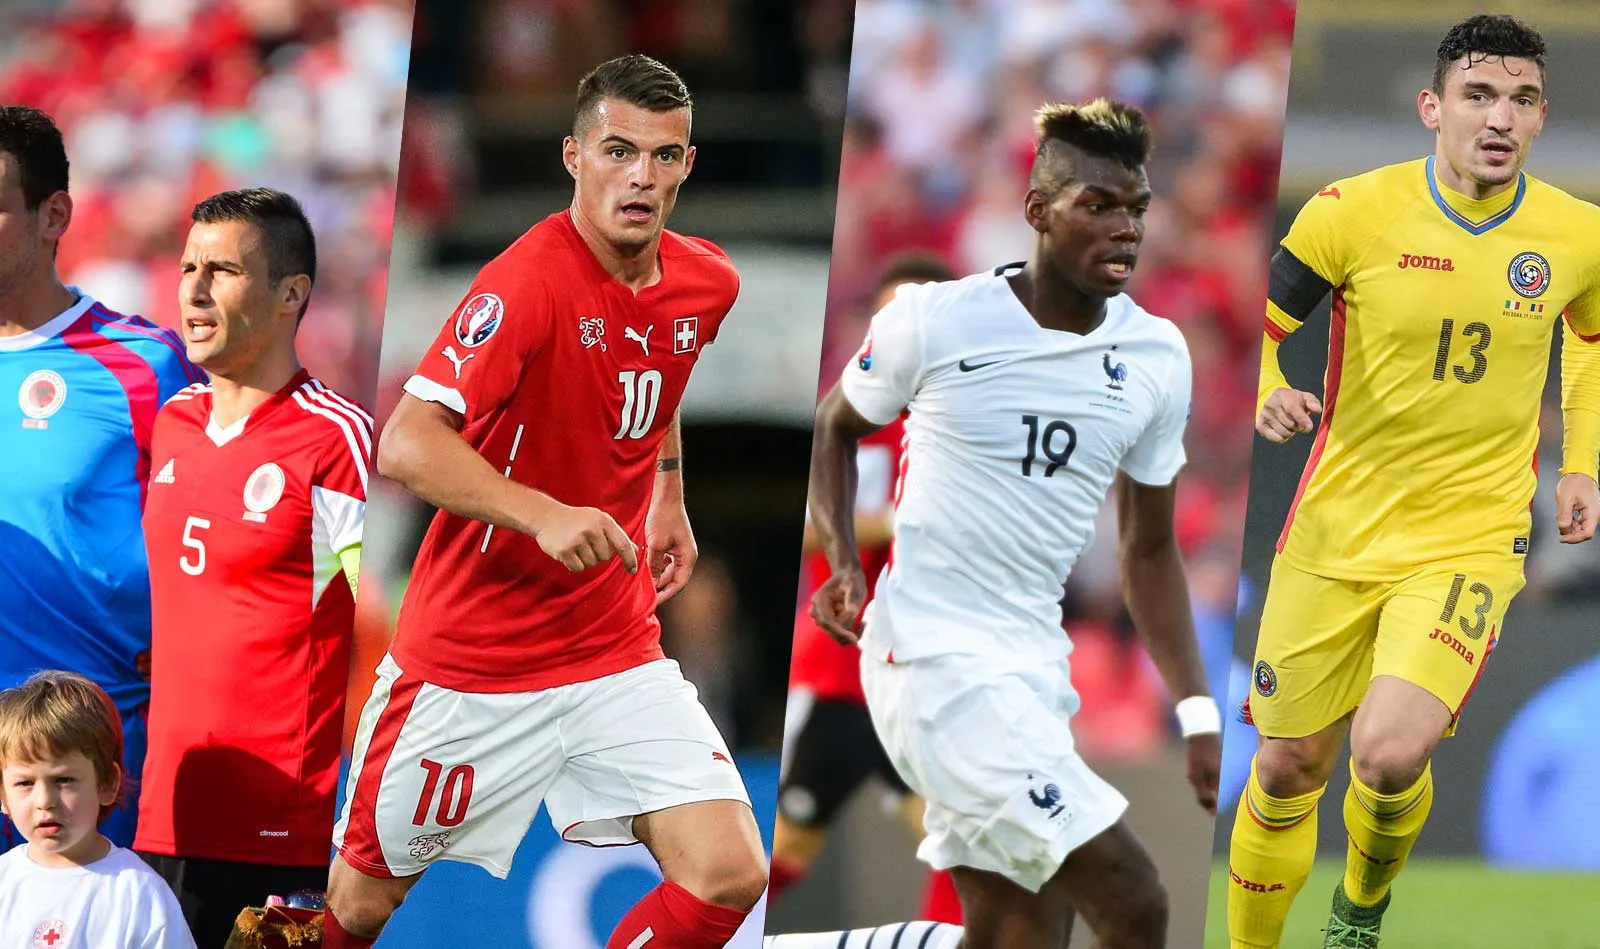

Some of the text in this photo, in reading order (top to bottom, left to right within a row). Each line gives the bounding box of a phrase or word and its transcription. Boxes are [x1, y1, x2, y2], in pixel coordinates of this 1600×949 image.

[1398, 253, 1455, 272] Joma
[1432, 318, 1492, 385] 13
[614, 370, 663, 440] 10
[1021, 415, 1078, 478] 19
[180, 515, 211, 576] 5
[1439, 573, 1494, 640] 13
[1429, 628, 1474, 666] Joma
[412, 758, 475, 828] 10
